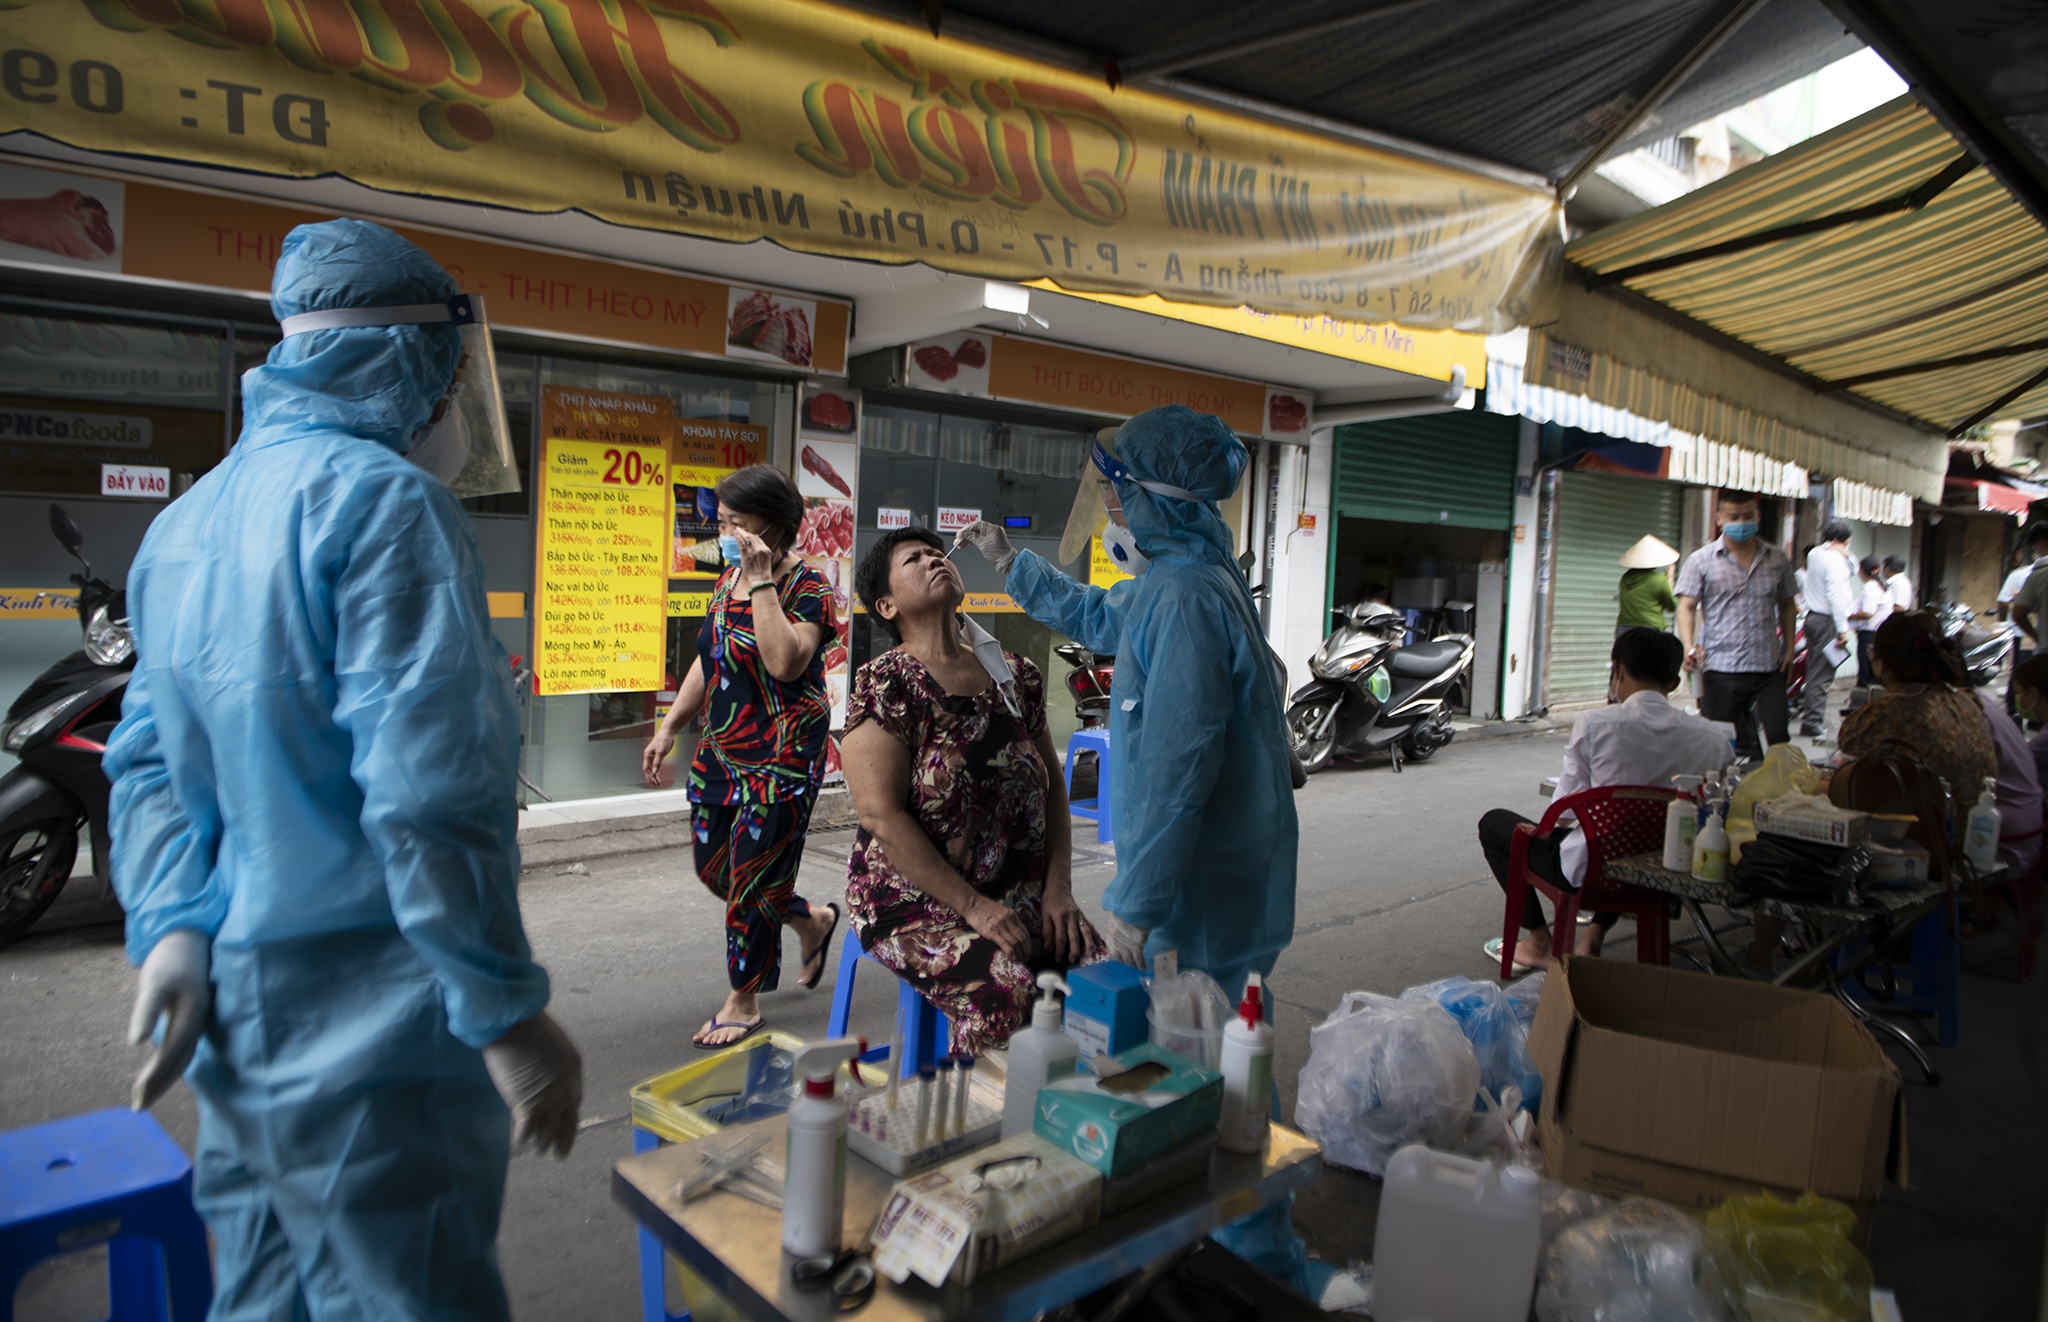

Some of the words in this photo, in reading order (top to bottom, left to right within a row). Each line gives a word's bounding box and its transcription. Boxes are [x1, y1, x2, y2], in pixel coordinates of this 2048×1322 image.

[503, 273, 577, 312] THỊT
[588, 288, 652, 319] HEO
[664, 299, 706, 329] MỸ
[1032, 365, 1074, 392] THỊT
[1079, 372, 1103, 394] BÒ
[1109, 376, 1133, 399] ÚC
[620, 433, 639, 445] BAN
[642, 435, 662, 447] NHA
[682, 426, 716, 439] KHOAI
[718, 428, 739, 440] TÂY
[602, 449, 664, 486] 20%
[107, 467, 134, 490] ĐẨY
[139, 472, 165, 492] VÀO
[880, 511, 893, 525] ĐẨY
[895, 514, 908, 526] VÀO
[940, 511, 954, 524] KÉO
[622, 553, 638, 562] Ban
[641, 553, 658, 563] Nha
[567, 582, 580, 592] vai
[573, 640, 590, 649] heo
